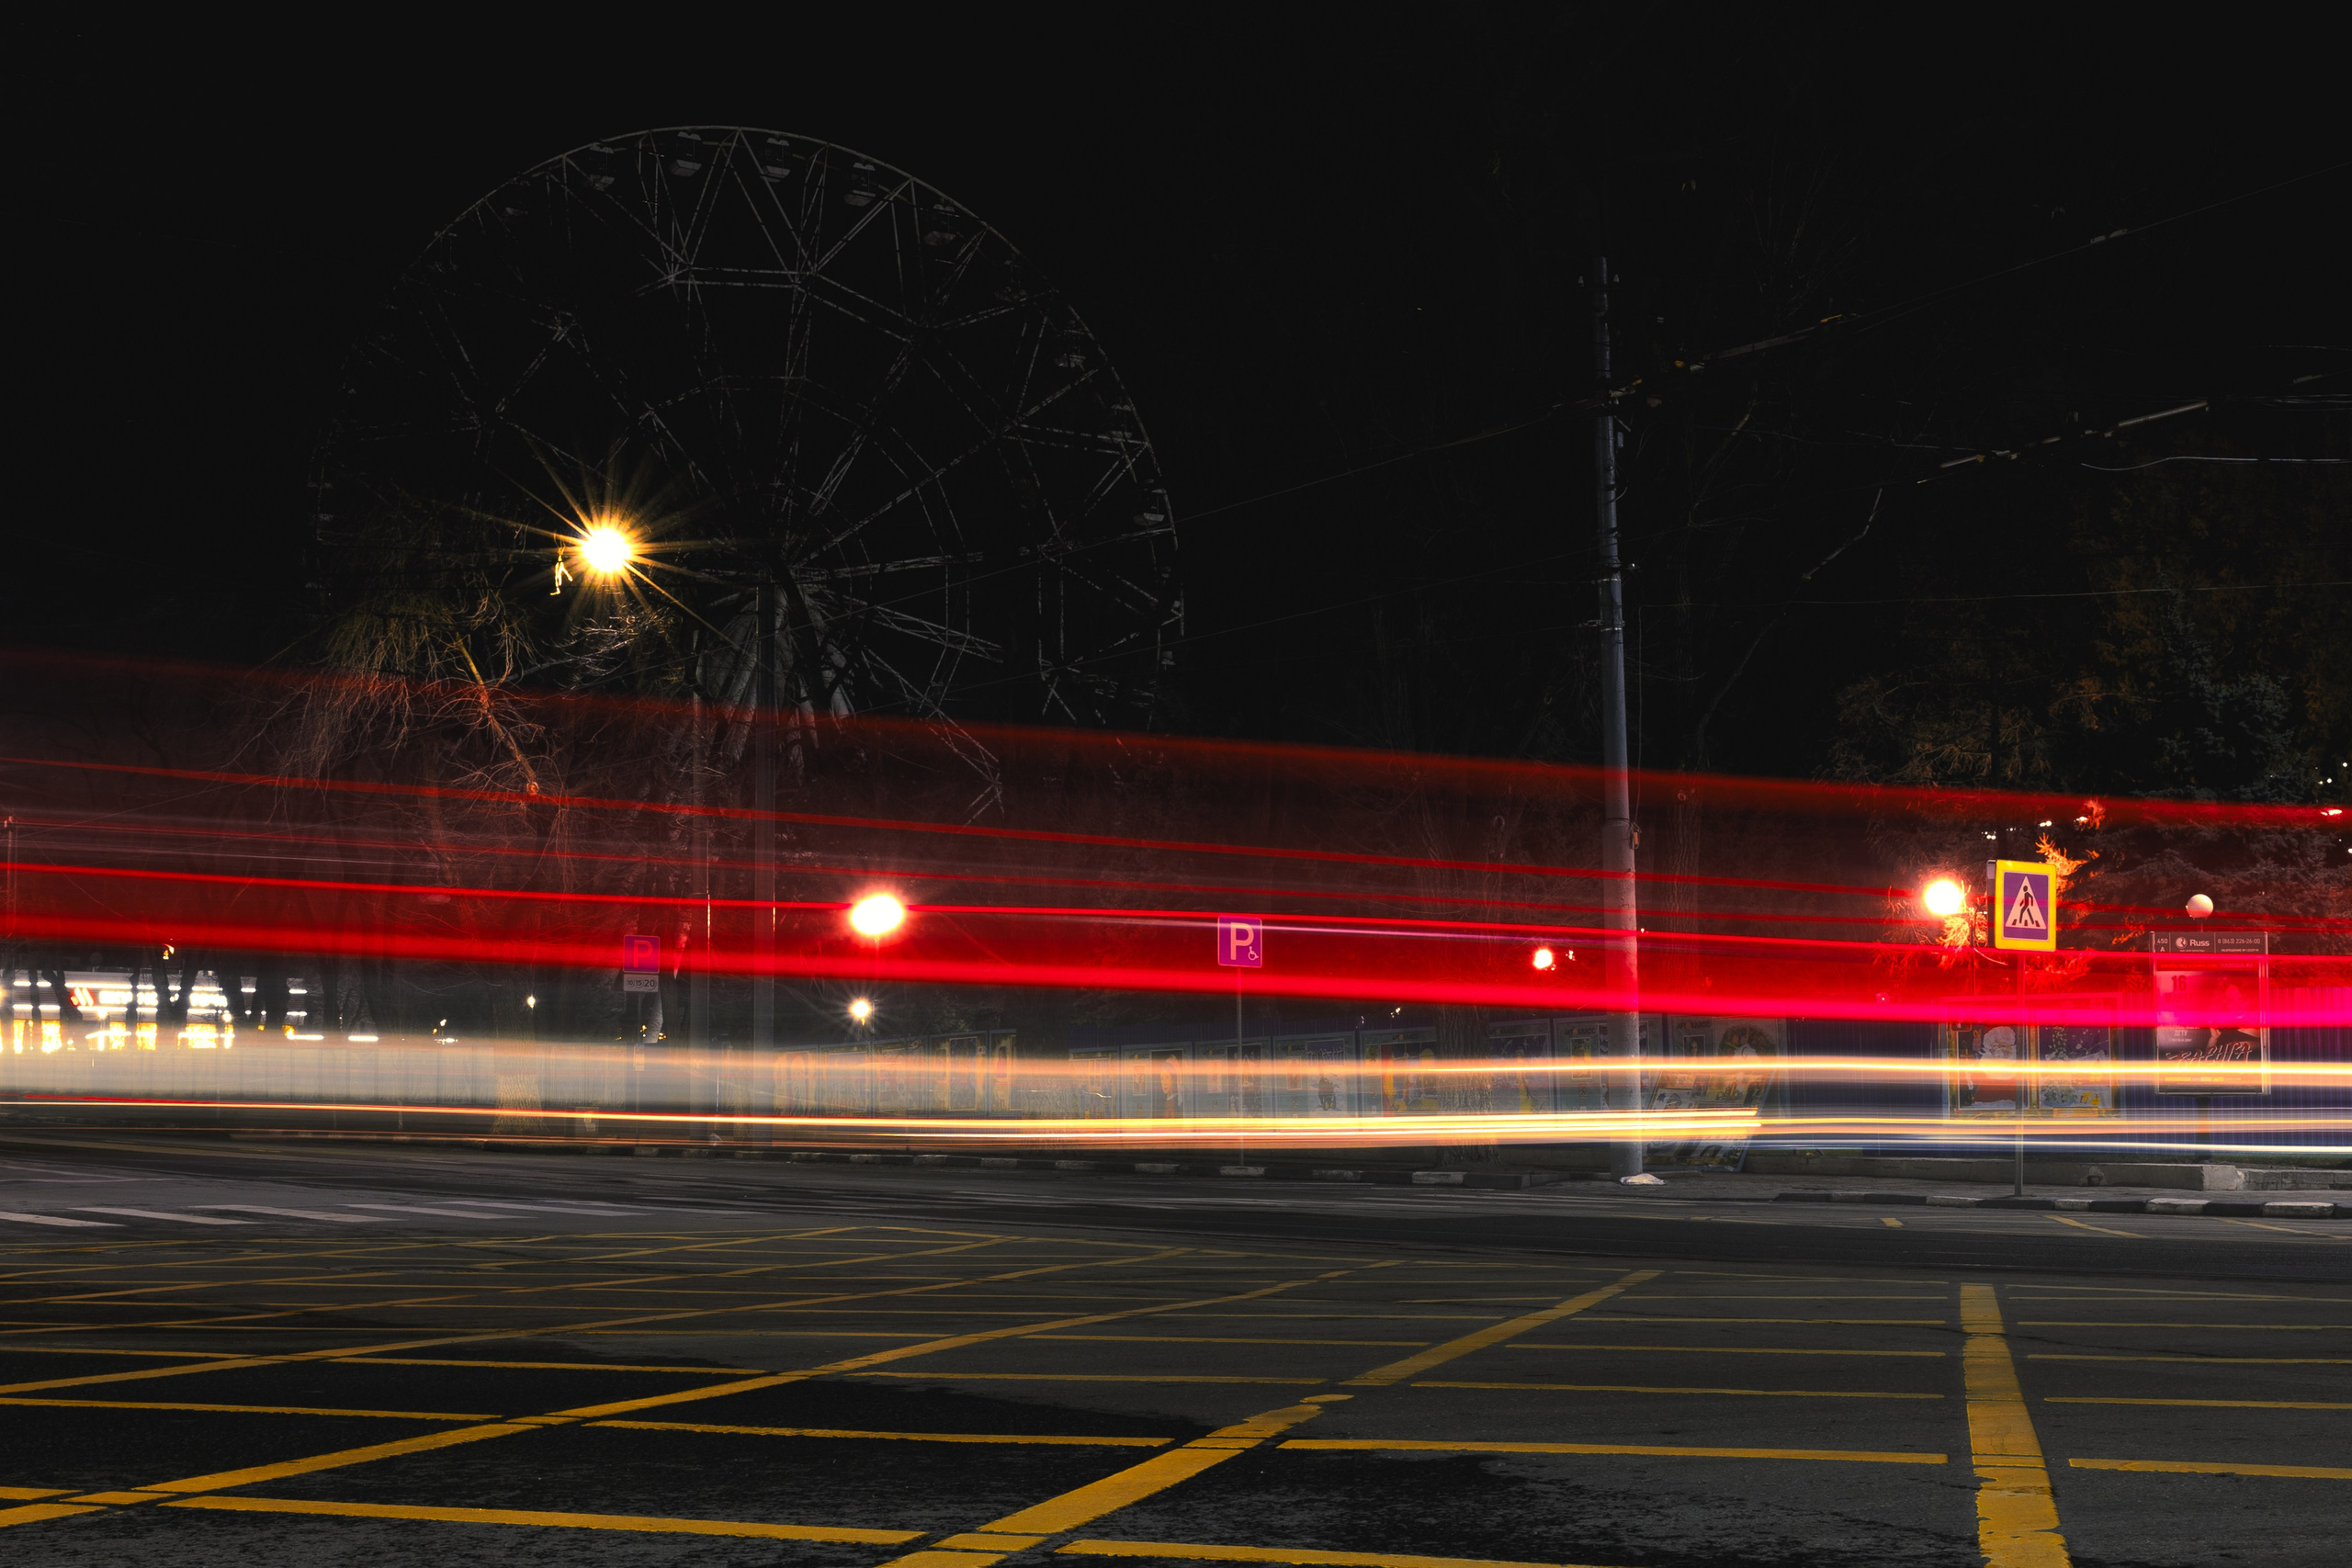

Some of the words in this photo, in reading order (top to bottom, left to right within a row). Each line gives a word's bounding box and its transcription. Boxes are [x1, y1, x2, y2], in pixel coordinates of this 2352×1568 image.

[1230, 922, 1255, 961] P
[2189, 939, 2211, 947] Russ
[632, 940, 653, 968] P
[644, 979, 655, 987] 20
[2171, 975, 2187, 991] 16
